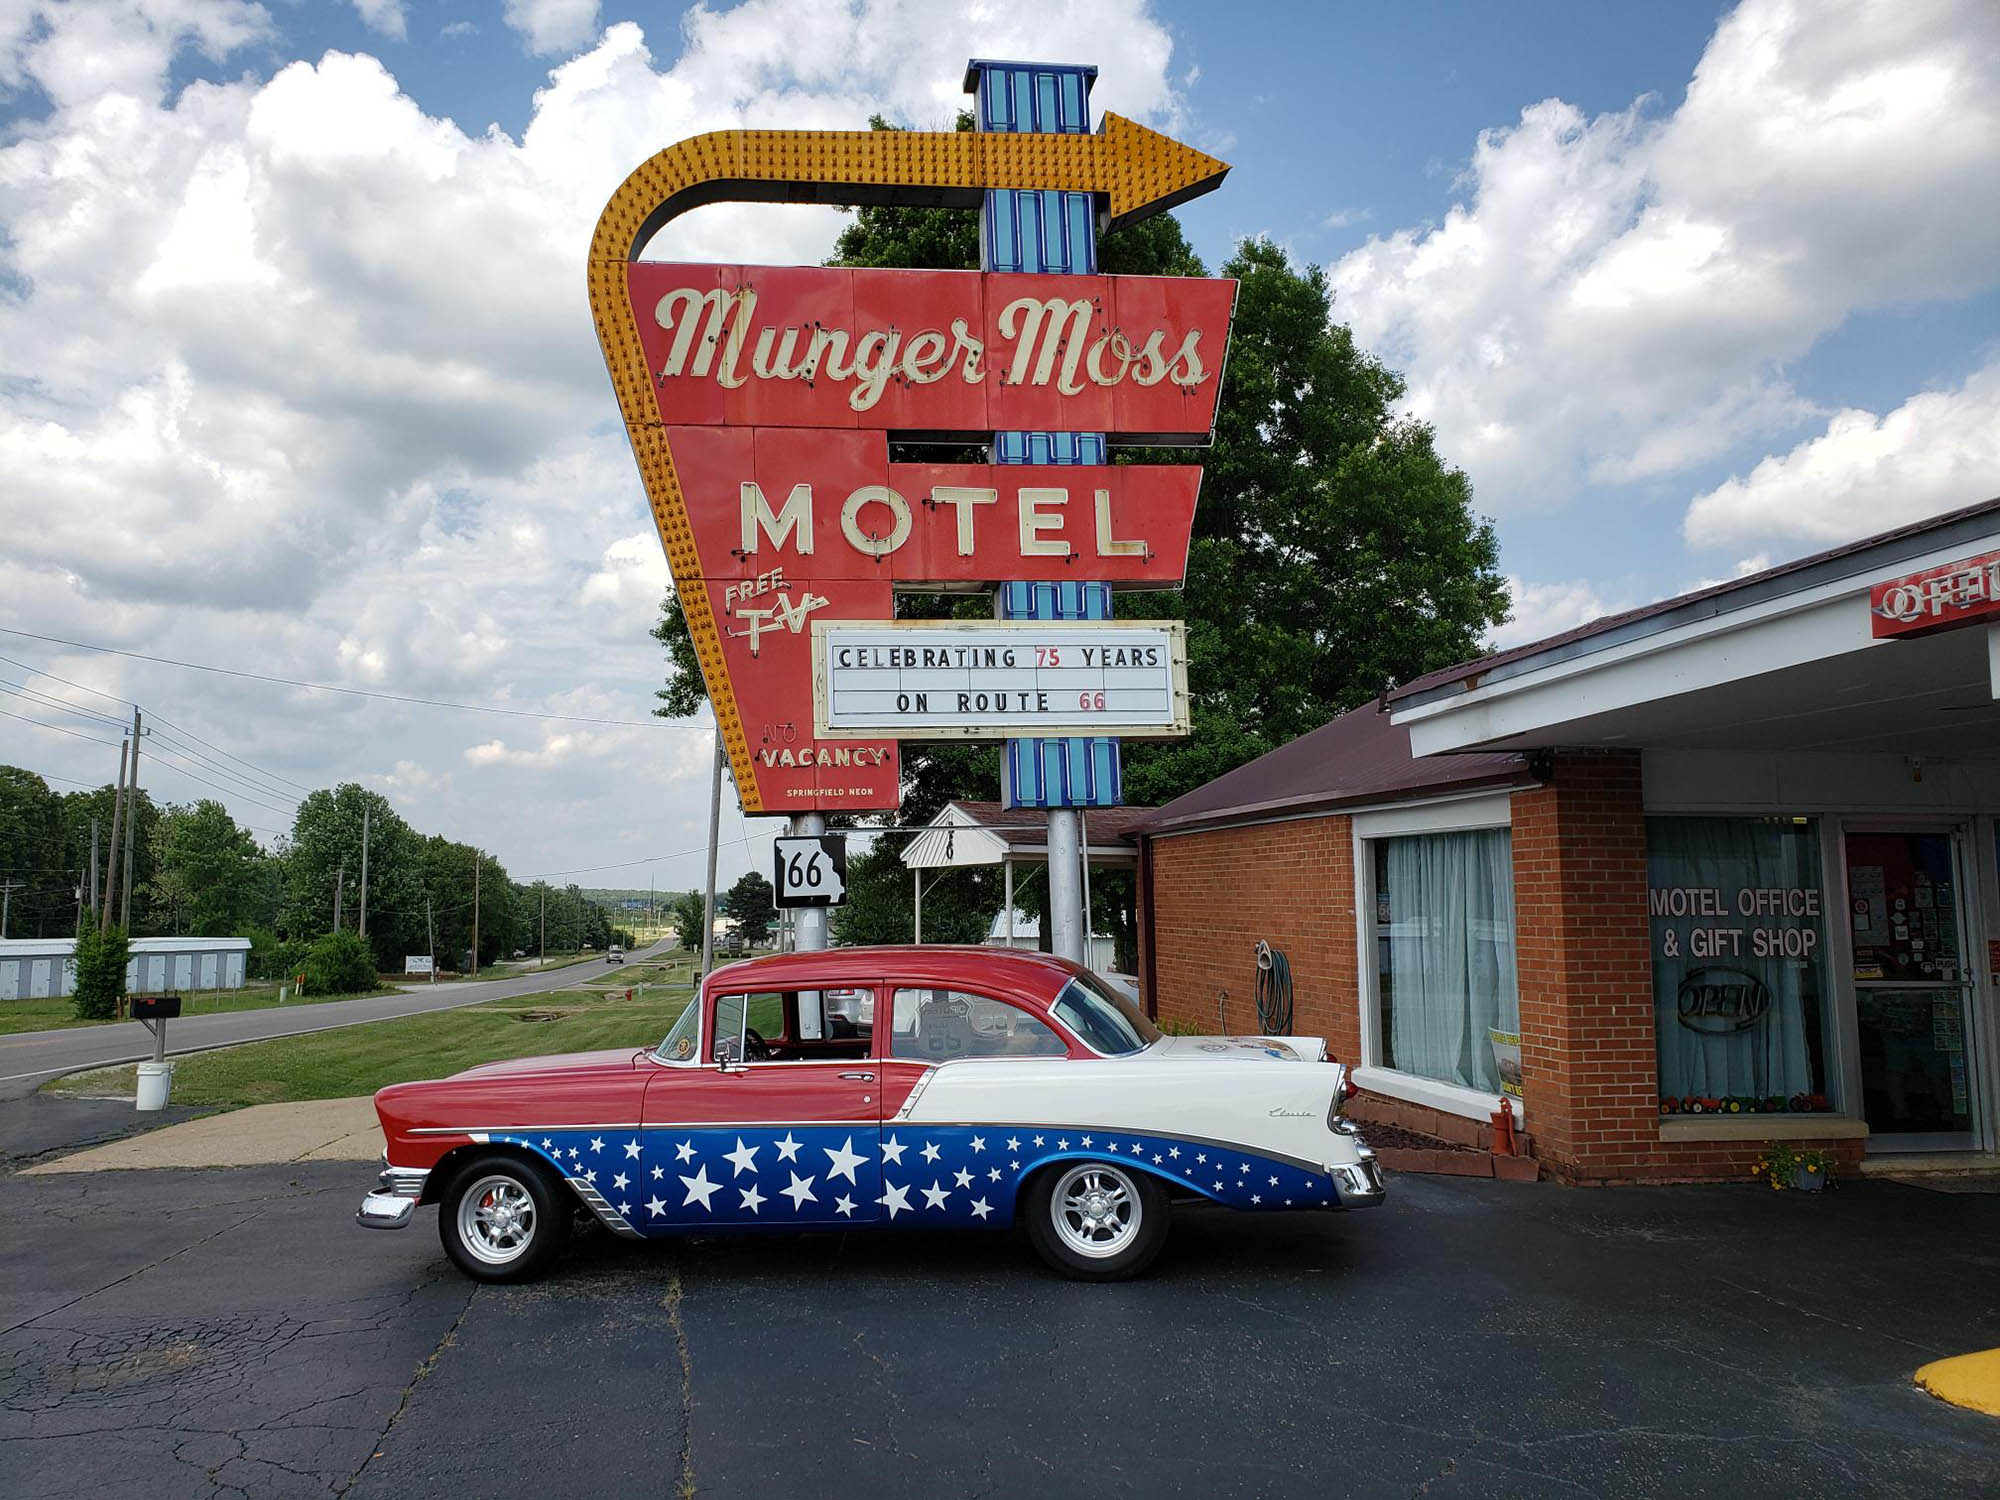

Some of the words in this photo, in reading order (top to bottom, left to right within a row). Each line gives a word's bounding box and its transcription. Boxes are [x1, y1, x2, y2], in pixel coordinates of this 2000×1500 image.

[655, 288, 986, 412] Munger
[998, 297, 1211, 396] Moss
[740, 482, 1148, 557] MOTEL
[725, 566, 783, 608] FREE
[1882, 560, 2000, 623] OFFI
[735, 592, 814, 651] TV
[838, 647, 1016, 668] CELEBRATING
[1035, 647, 1061, 667] 75
[1081, 647, 1159, 667] YEARS
[896, 692, 929, 713] ON
[957, 692, 1049, 713] ROUTE
[1079, 691, 1105, 711] 66
[763, 723, 797, 743] NO
[760, 748, 887, 768] VACANCY
[786, 788, 845, 797] SPRINGFIELD
[849, 788, 873, 796] NEON
[788, 850, 822, 889] 66
[1649, 888, 1729, 917] MOTEL
[1737, 888, 1820, 917] OFFICE
[1663, 928, 1680, 958] &
[1690, 928, 1743, 958] GIFT
[1752, 928, 1817, 958] SHOP
[1680, 984, 1763, 1017] OPEN
